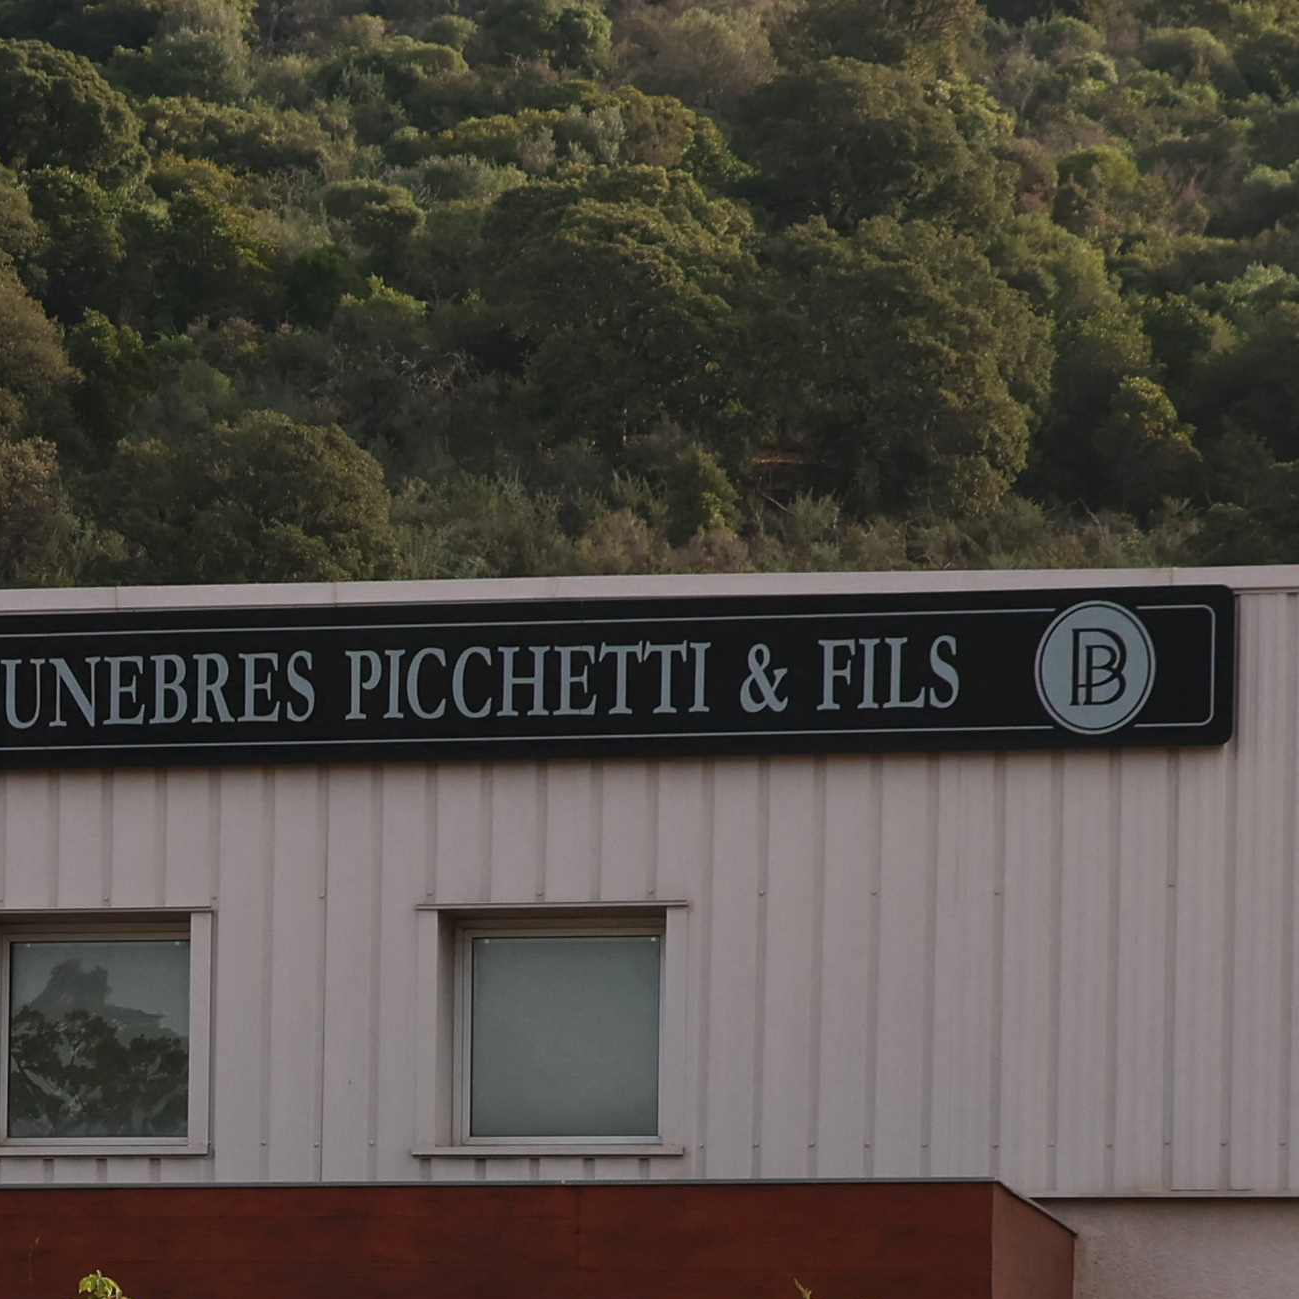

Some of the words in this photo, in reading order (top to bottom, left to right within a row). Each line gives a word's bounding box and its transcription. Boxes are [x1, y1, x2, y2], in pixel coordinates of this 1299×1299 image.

[344, 639, 712, 721] PICCHETTI
[739, 643, 790, 713] &
[816, 635, 961, 711] FILS
